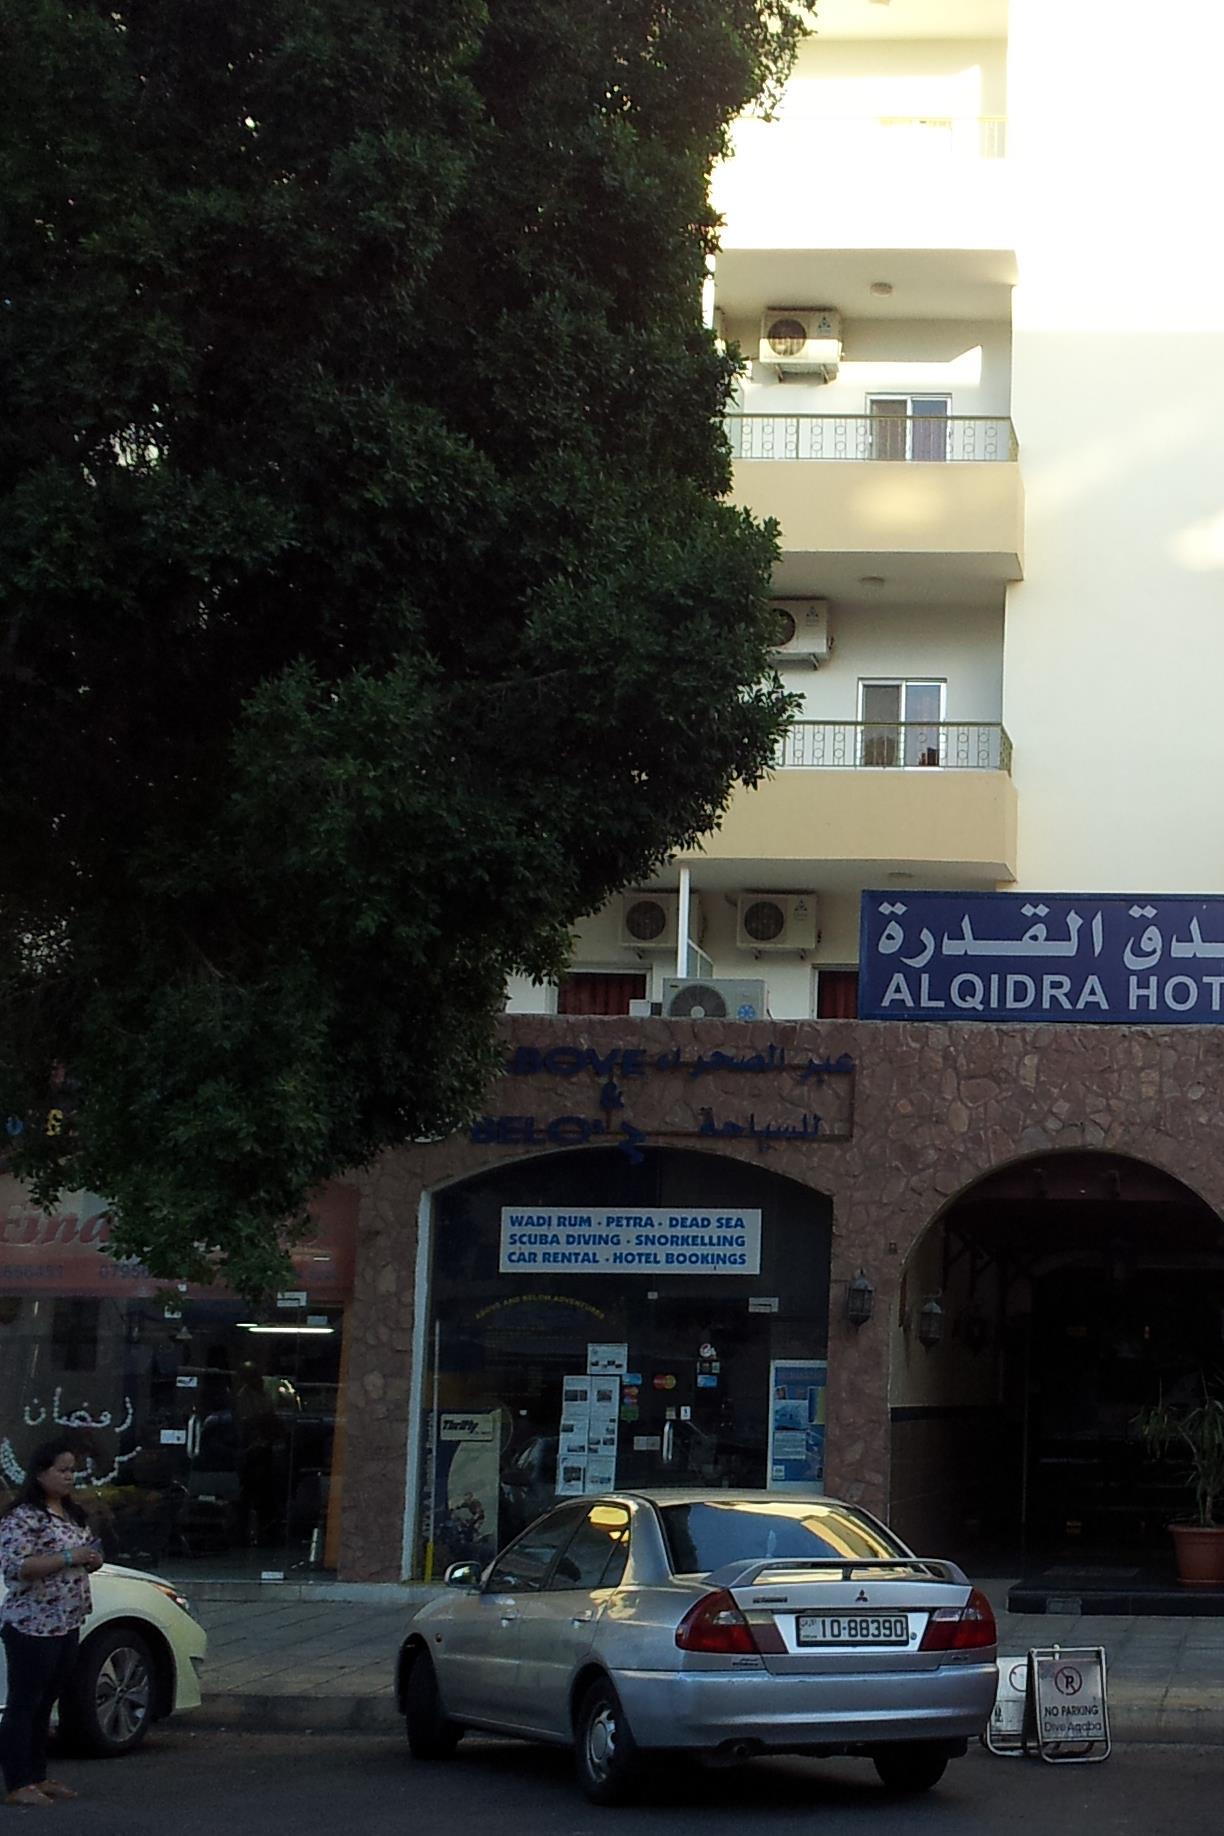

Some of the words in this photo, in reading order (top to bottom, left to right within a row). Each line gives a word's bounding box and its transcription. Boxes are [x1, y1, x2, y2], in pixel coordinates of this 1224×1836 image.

[878, 903, 1103, 968] القدرة
[881, 973, 1110, 1011] ALQIDRA
[504, 1046, 647, 1077] BOVE
[509, 1215, 551, 1229] WADI
[556, 1215, 592, 1229] RUM
[606, 1216, 654, 1229] PETRA
[668, 1216, 711, 1229] DEAD
[715, 1216, 745, 1229] SEA
[509, 1233, 560, 1246] SCUBA
[566, 1234, 621, 1247] DIVING
[635, 1234, 746, 1248] SNORKELLING
[507, 1251, 537, 1265] CAR
[542, 1252, 599, 1265] RENTAL
[613, 1252, 661, 1265] HOTEL
[665, 1252, 747, 1266] BOOKINGS
[1044, 1706, 1059, 1718] NO
[1061, 1705, 1099, 1717] PARKING
